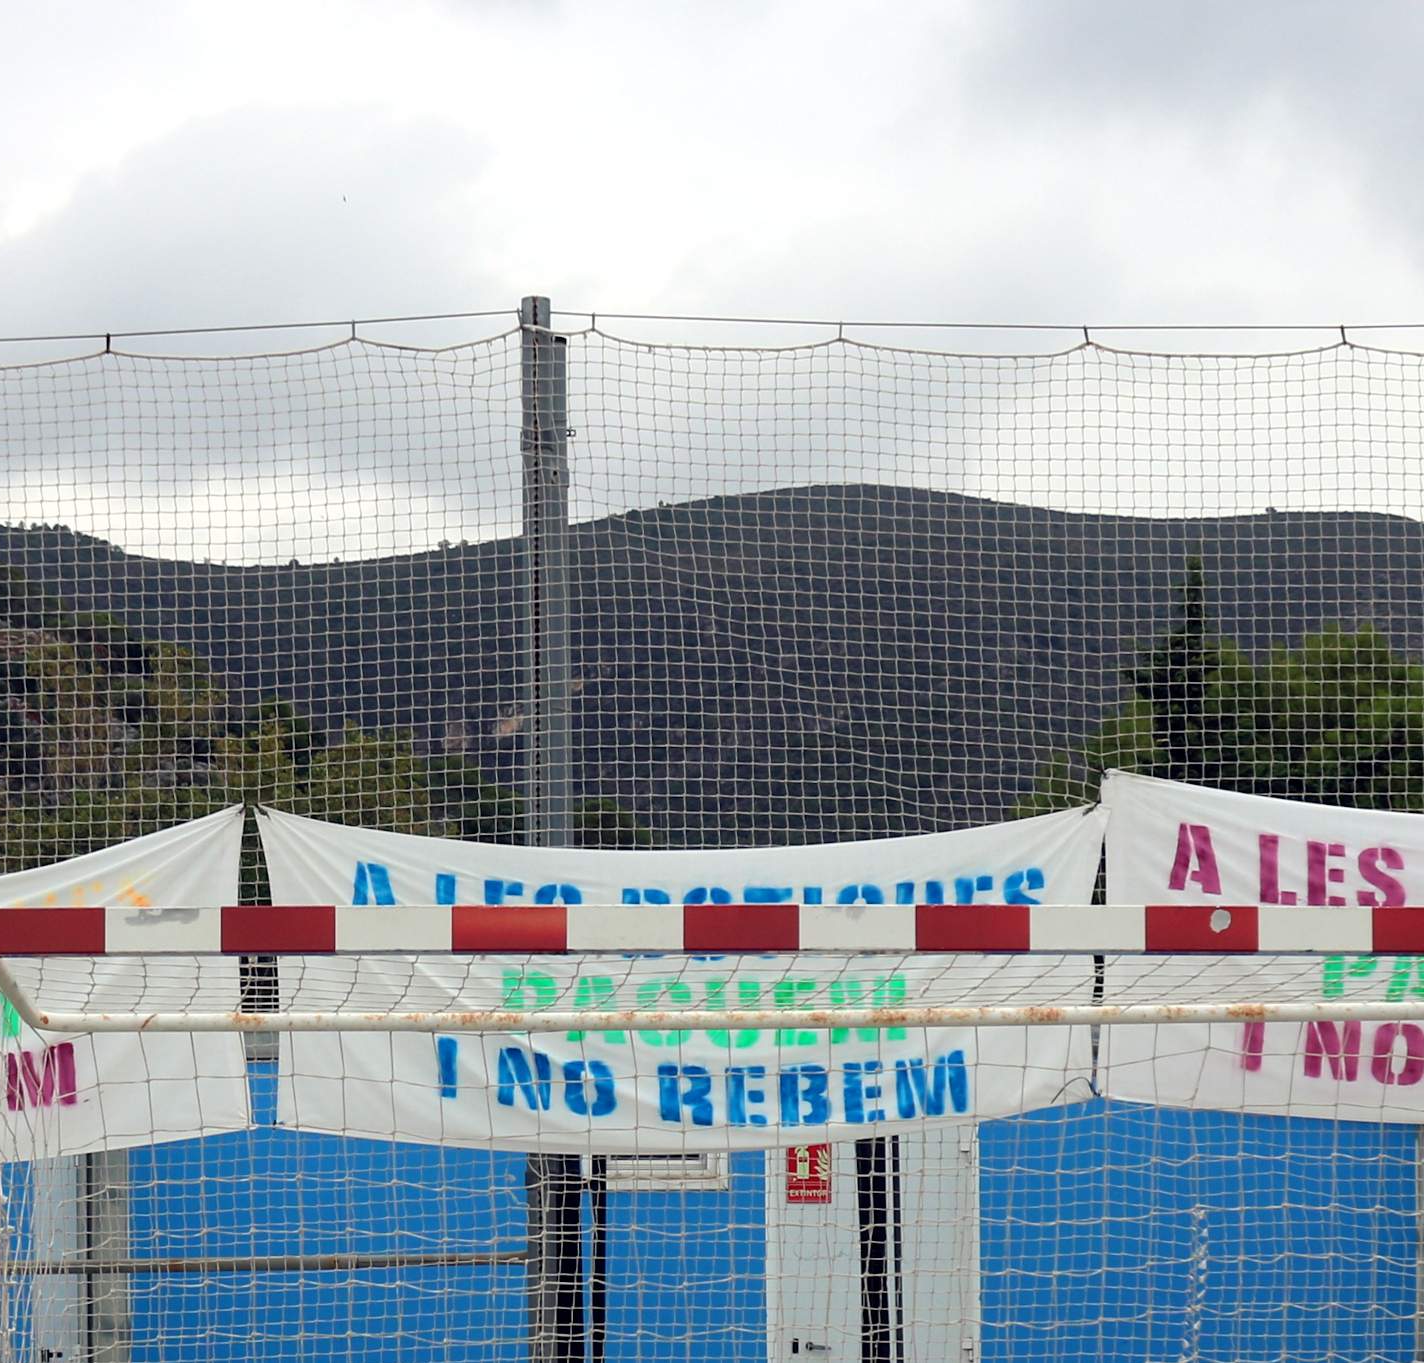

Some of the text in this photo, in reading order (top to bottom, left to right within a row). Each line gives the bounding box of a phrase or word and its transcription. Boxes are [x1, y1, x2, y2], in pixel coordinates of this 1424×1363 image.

[1168, 823, 1222, 896] A
[1257, 833, 1407, 908] LES
[437, 1035, 969, 1128] I NO REBEM
